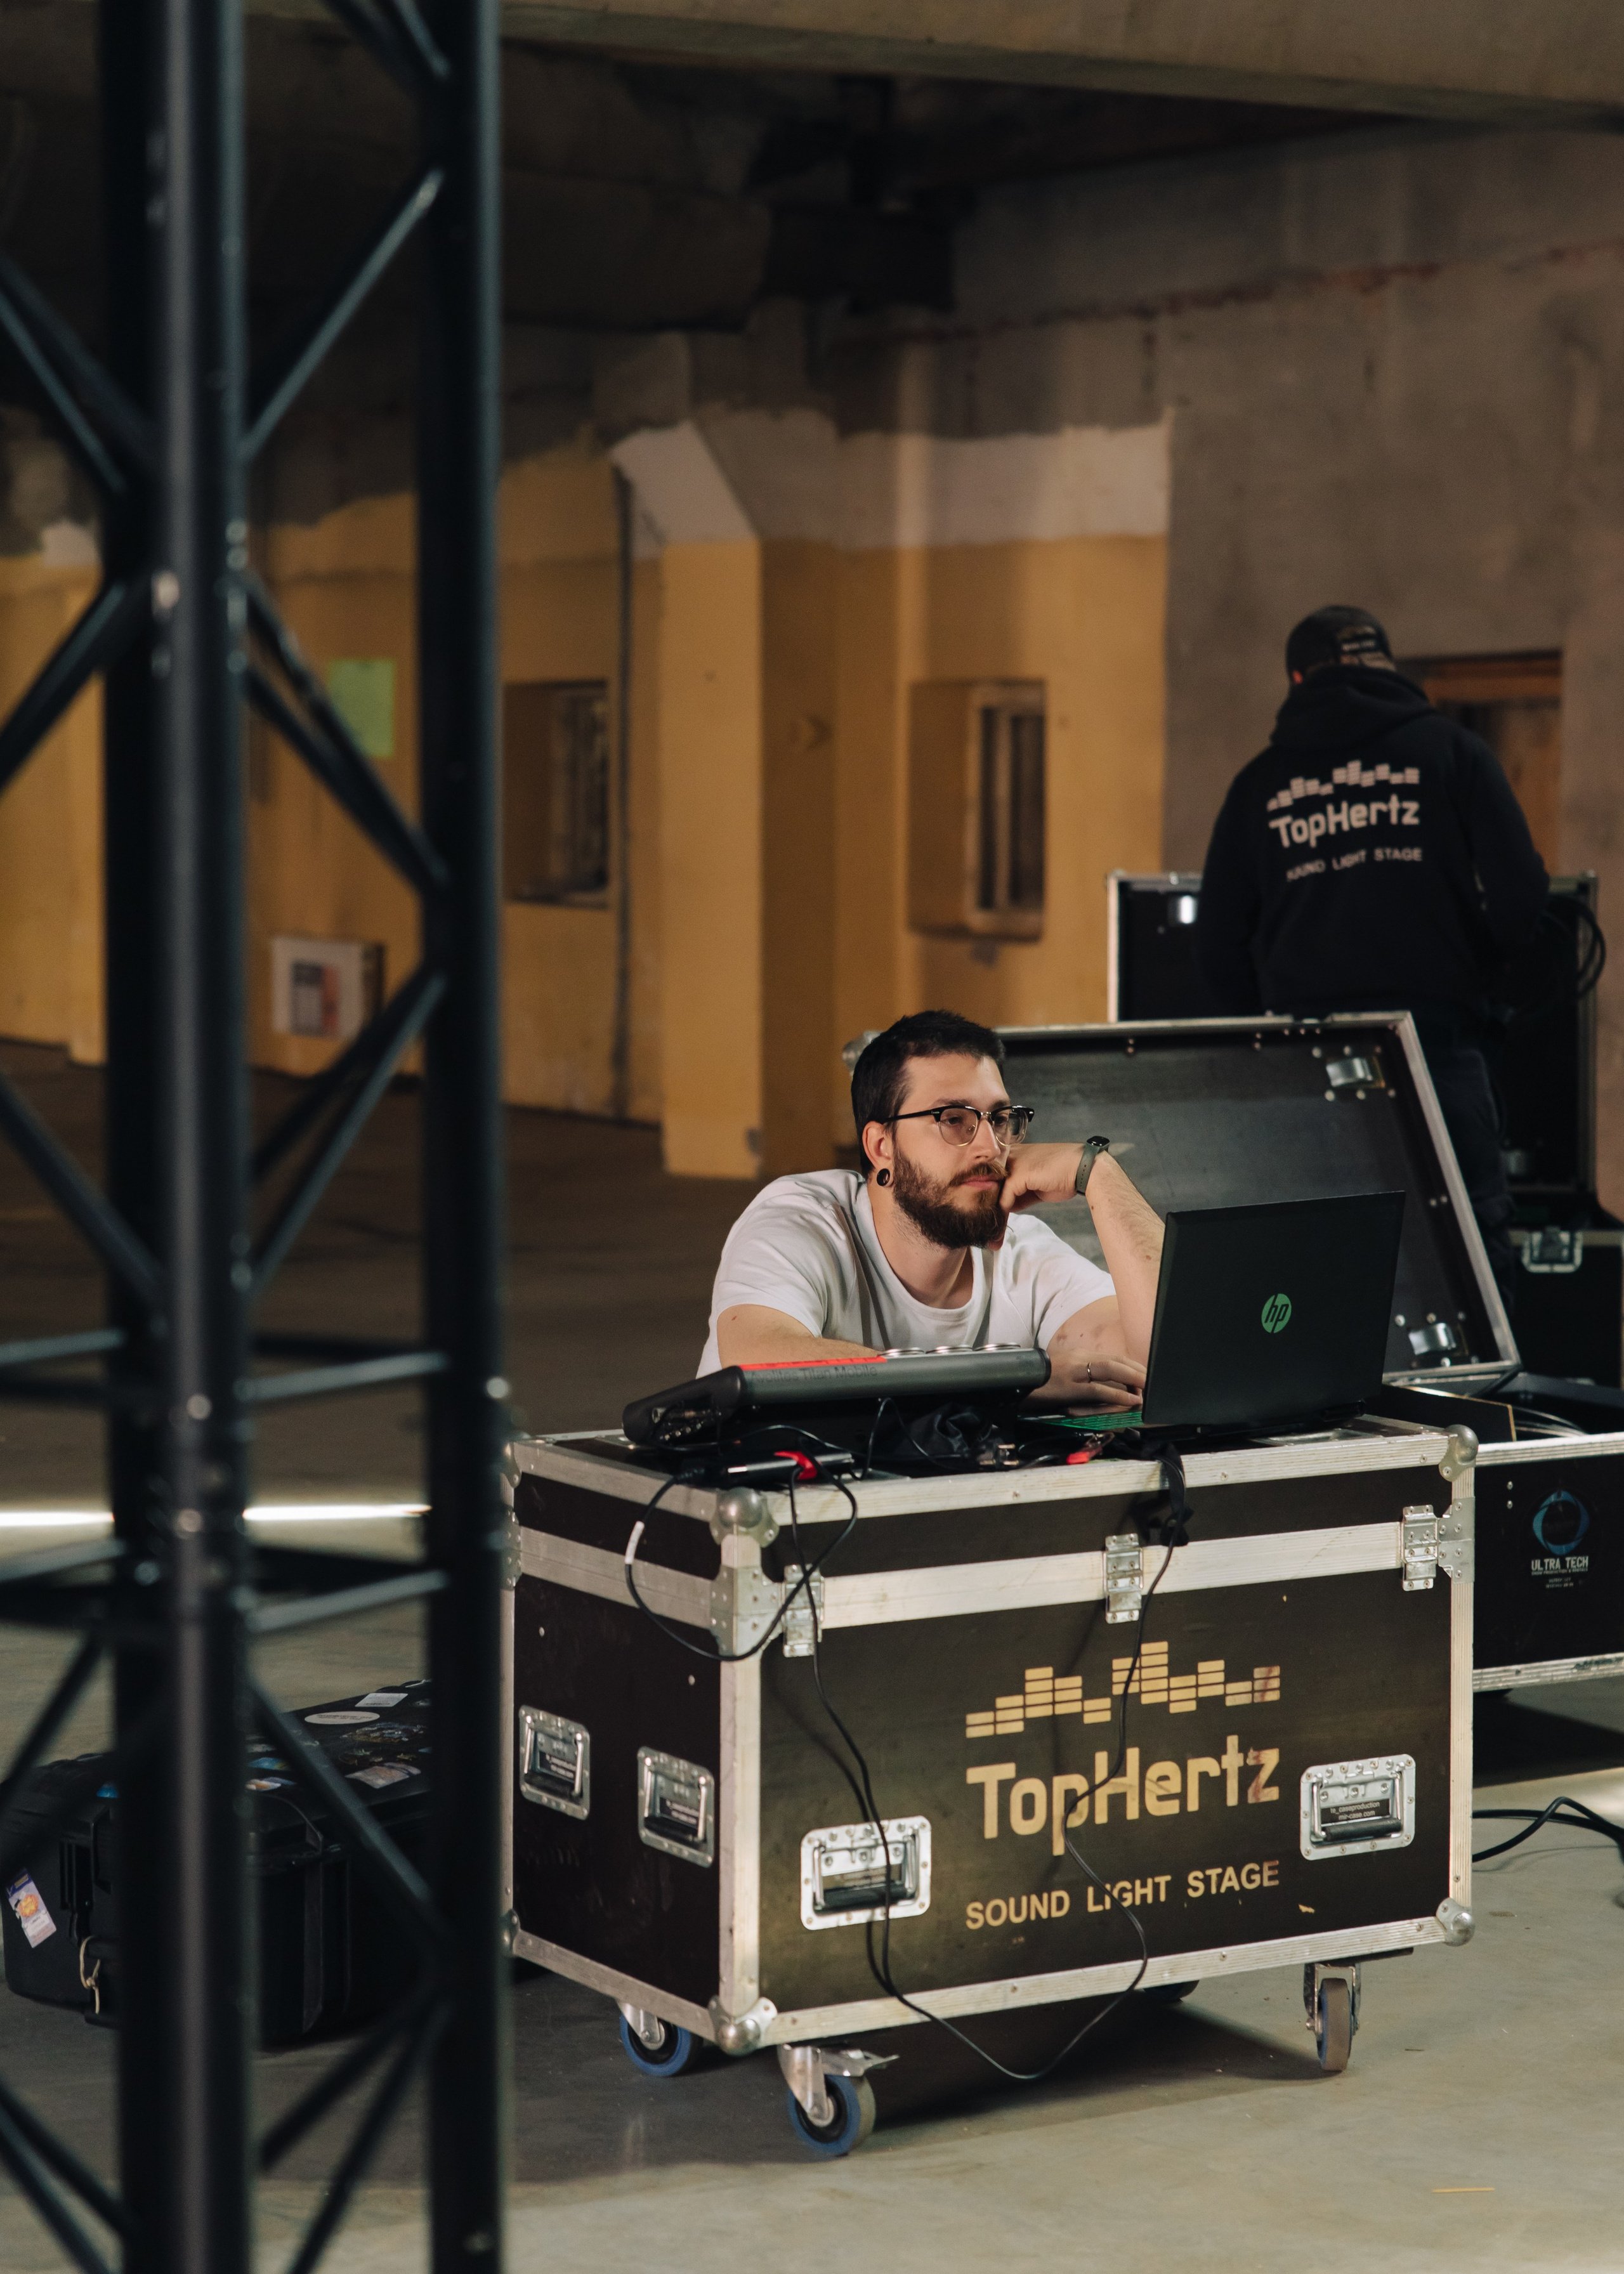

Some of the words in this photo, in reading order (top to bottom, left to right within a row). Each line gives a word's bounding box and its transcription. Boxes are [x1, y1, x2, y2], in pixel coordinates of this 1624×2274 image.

[1269, 795, 1420, 847] TopHertz
[1373, 847, 1422, 861] STAGE
[1262, 1293, 1290, 1333] hp
[834, 1364, 877, 1378] Mobile
[1531, 1558, 1561, 1571] ULTRA
[1565, 1555, 1588, 1569] TECH
[966, 1735, 1280, 1855] TopHertz
[966, 1890, 1070, 1930] SOUND
[1087, 1875, 1172, 1912] LIGHT
[1187, 1860, 1279, 1897] STAGE
